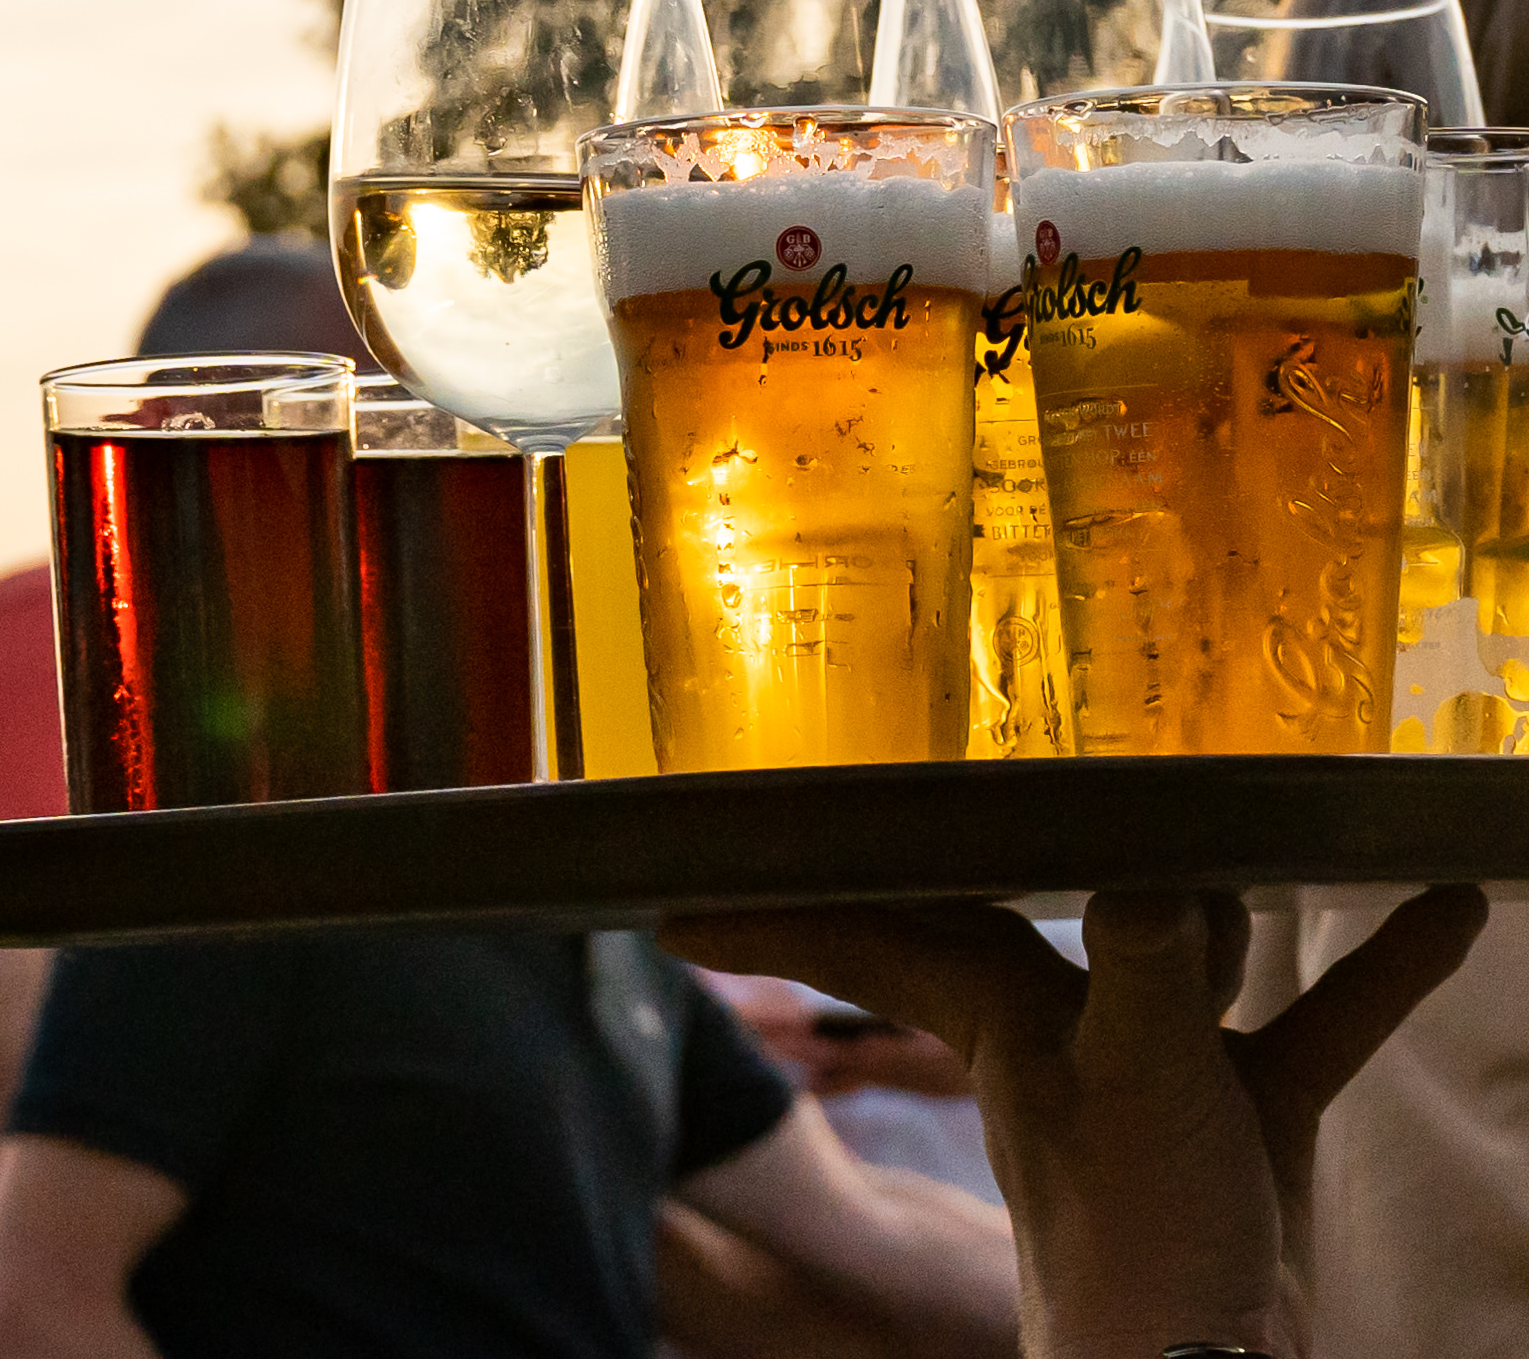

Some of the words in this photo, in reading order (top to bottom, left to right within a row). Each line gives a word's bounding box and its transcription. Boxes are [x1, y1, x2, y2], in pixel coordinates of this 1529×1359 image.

[709, 259, 914, 350] Grolsch
[812, 335, 863, 362] 1615
[1061, 323, 1096, 349] 1615
[1103, 421, 1153, 439] TWEE
